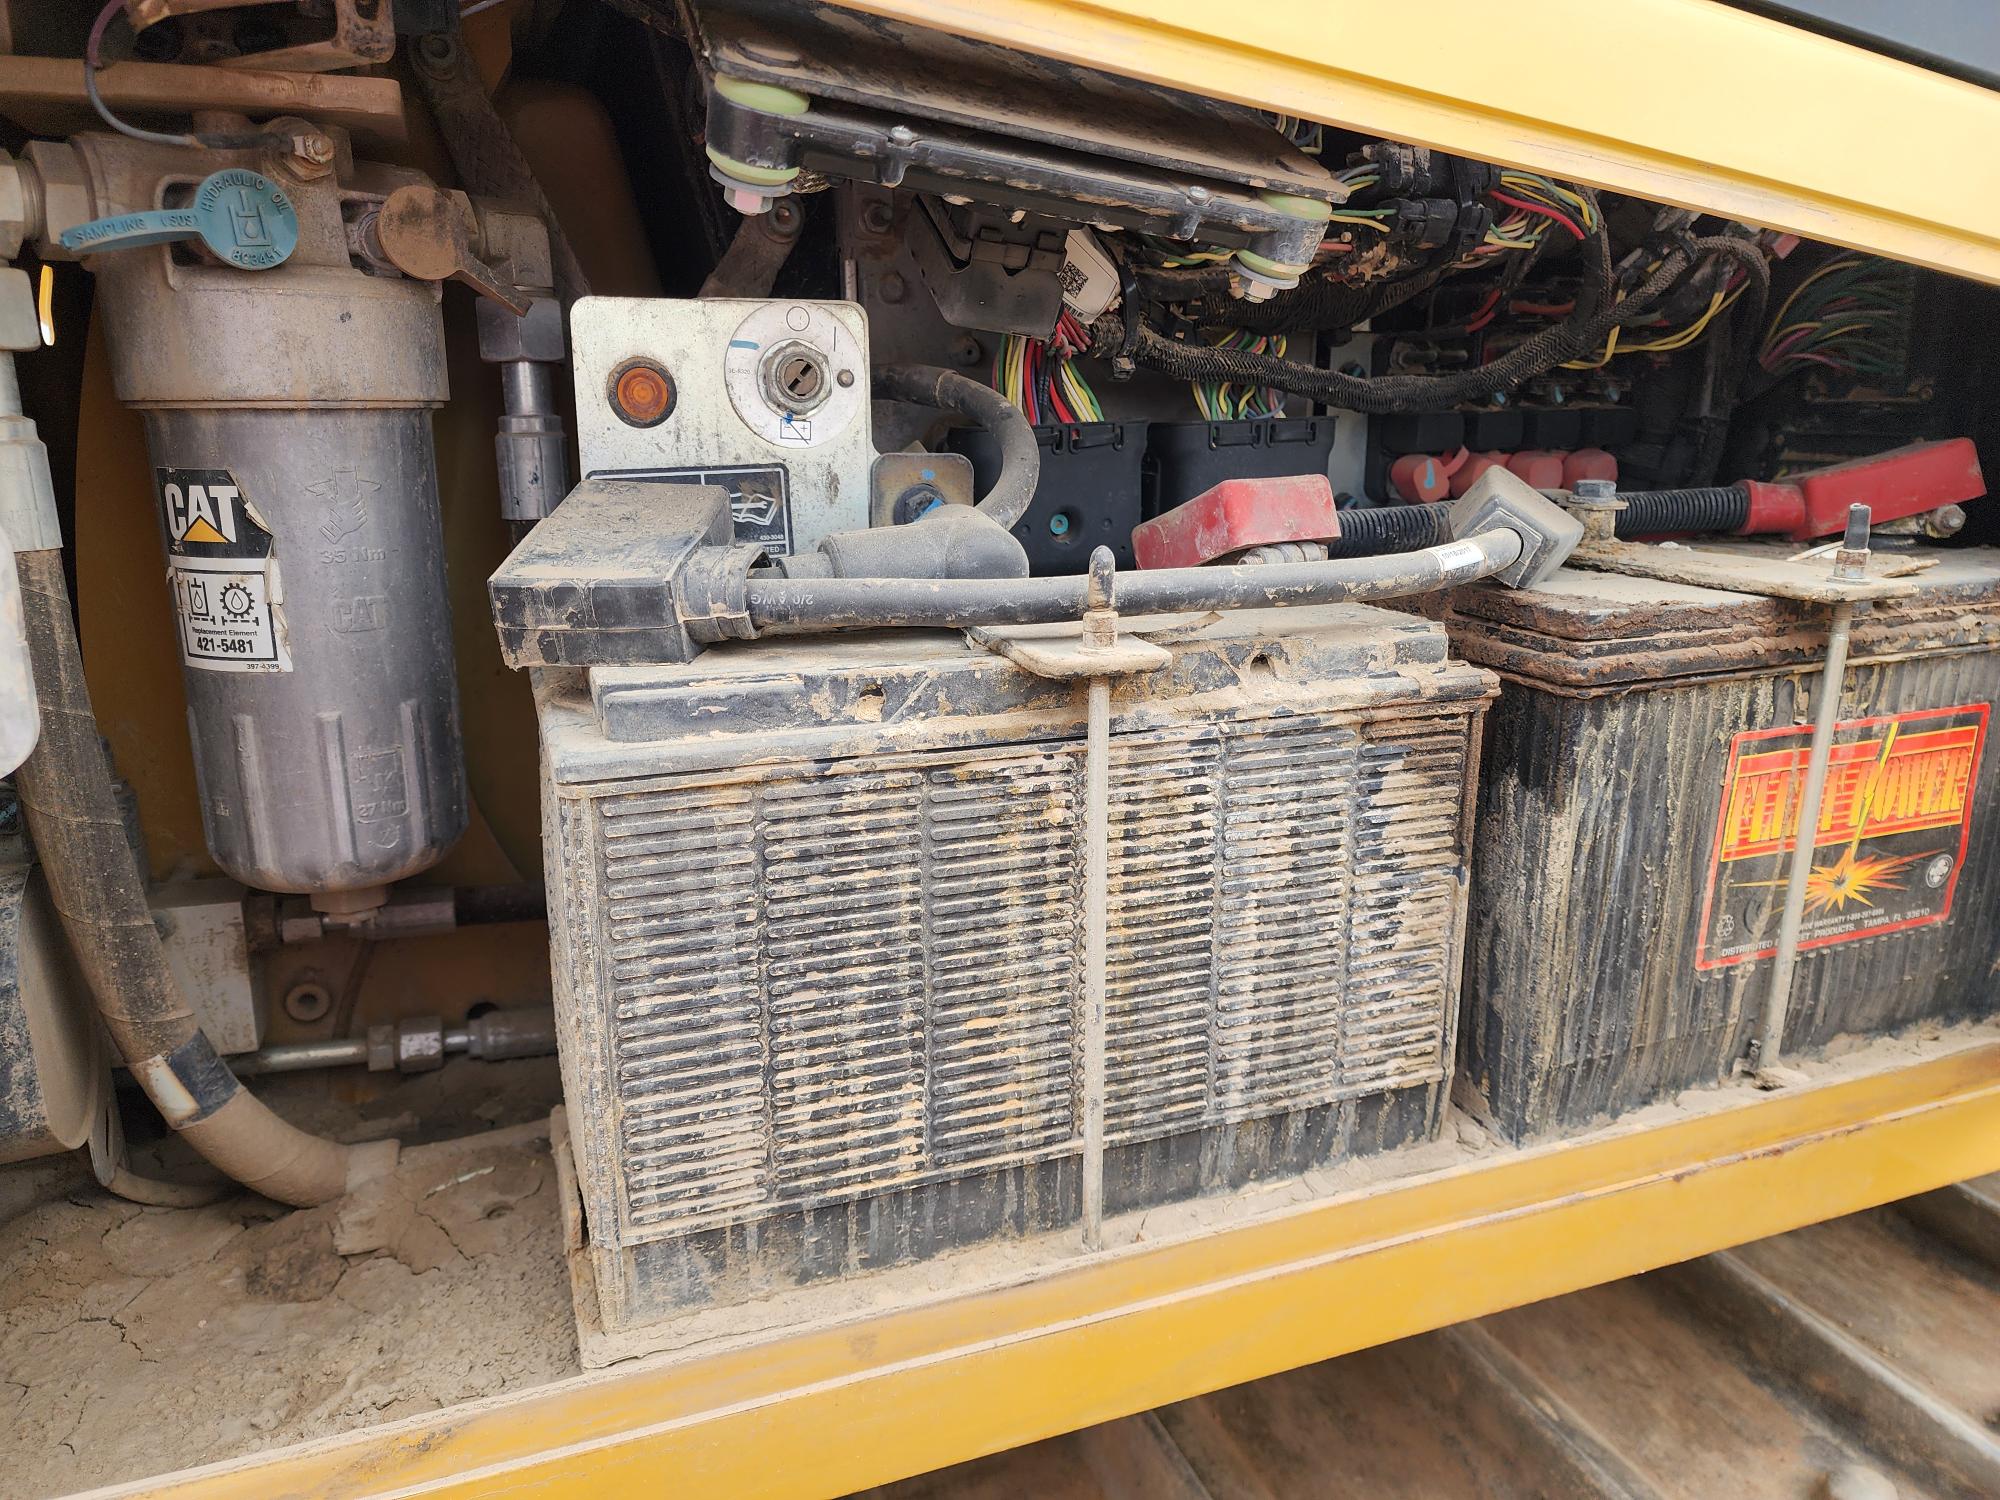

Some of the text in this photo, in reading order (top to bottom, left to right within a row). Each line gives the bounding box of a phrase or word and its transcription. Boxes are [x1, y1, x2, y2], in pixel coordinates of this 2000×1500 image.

[201, 172, 290, 216] HYDRAULIC OIL
[76, 218, 146, 243] SAMPLING
[164, 483, 239, 544] CAT
[320, 546, 386, 564] 35 Nm
[331, 595, 385, 634] CAT
[196, 636, 254, 654] 421-5481
[229, 629, 258, 637] Element
[1848, 746, 1971, 828] POWER
[1892, 913, 1903, 923] FL
